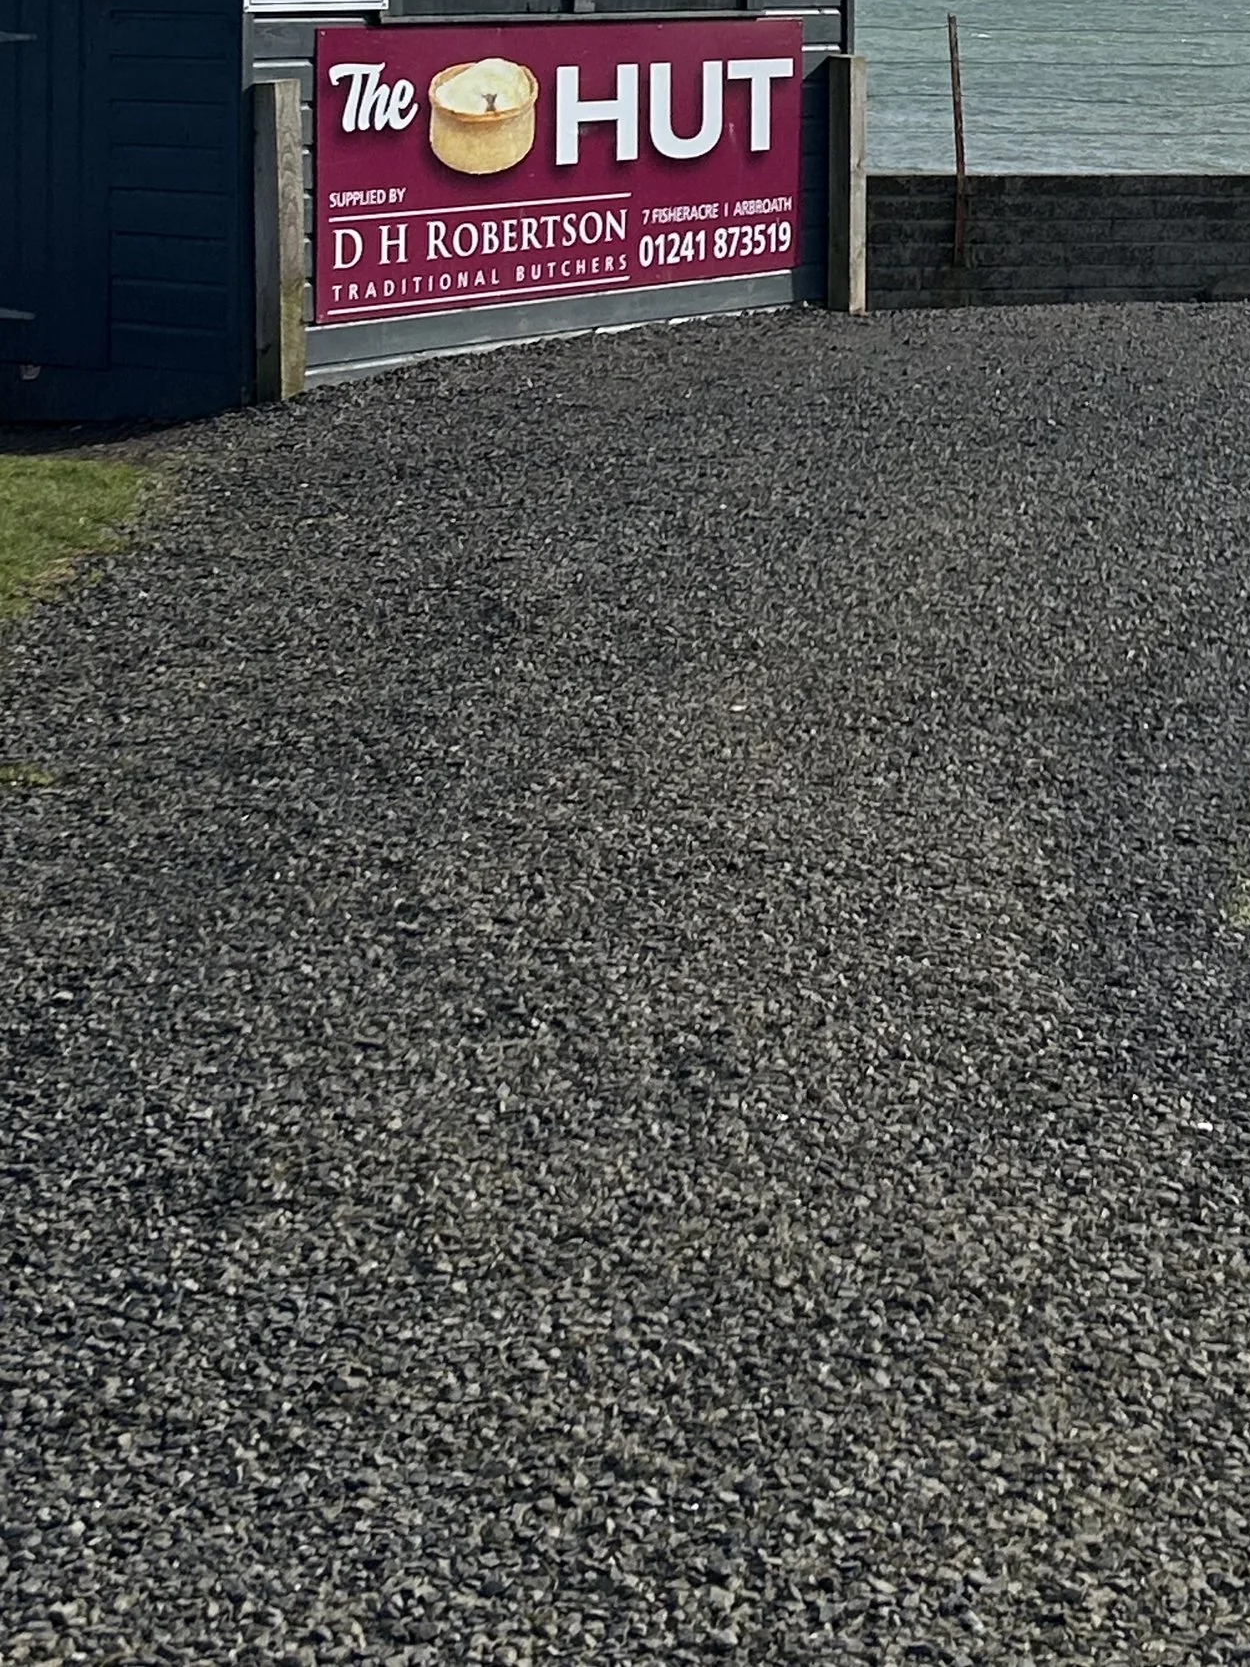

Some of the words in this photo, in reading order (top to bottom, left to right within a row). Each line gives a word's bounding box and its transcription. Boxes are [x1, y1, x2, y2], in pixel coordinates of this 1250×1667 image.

[329, 63, 418, 132] The
[556, 58, 793, 165] HUT
[330, 189, 386, 208] SUPPLIED
[388, 187, 406, 203] BY
[642, 209, 649, 224] 7
[652, 202, 719, 224] FISHERACRE
[733, 196, 792, 216] ARBROATH
[332, 228, 363, 270] D
[378, 223, 408, 265] H
[426, 209, 628, 260] ROBERTSON
[639, 232, 706, 268] 01241
[713, 221, 791, 260] 873519
[332, 268, 499, 302] TRADITIONAL
[516, 253, 628, 282] BUTCHERS
